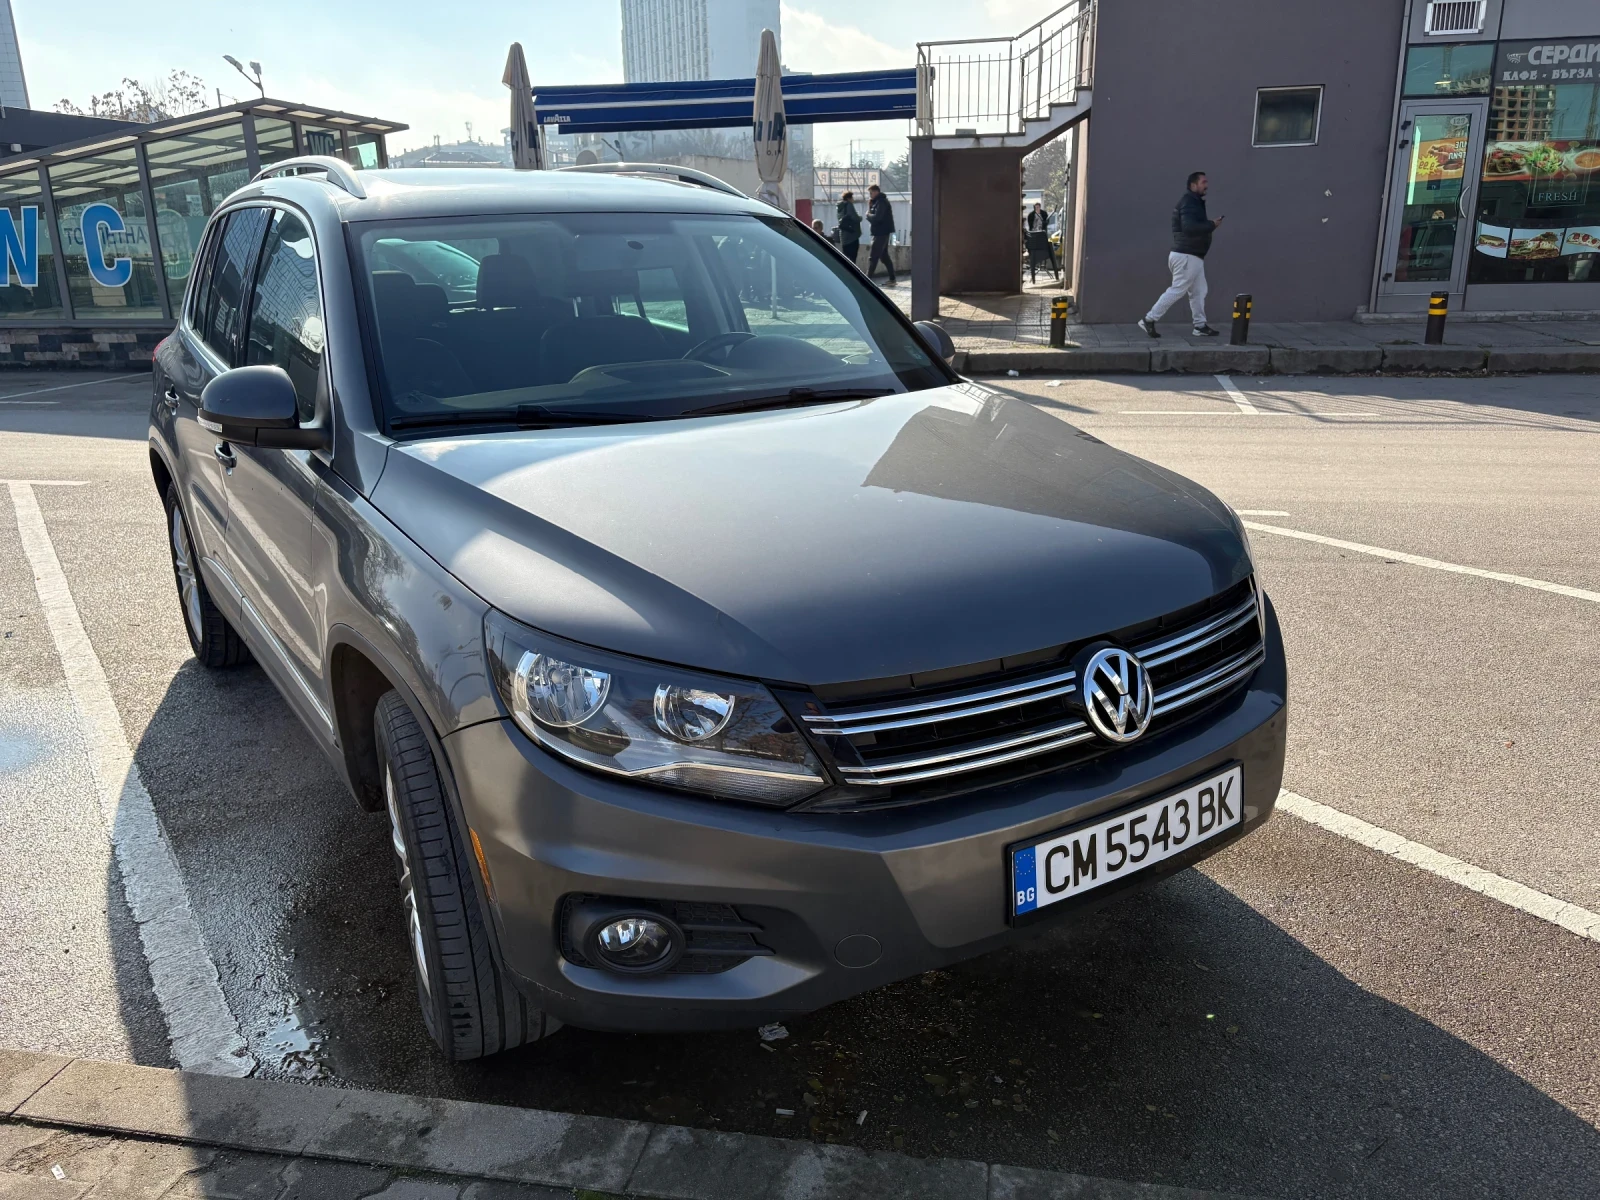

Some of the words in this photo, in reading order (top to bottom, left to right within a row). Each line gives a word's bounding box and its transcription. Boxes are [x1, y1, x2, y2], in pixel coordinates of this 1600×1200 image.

[1503, 70, 1538, 81] КАФЕ
[1538, 192, 1577, 201] FRESH
[1106, 799, 1190, 872] 5543
[1016, 887, 1035, 906] BG
